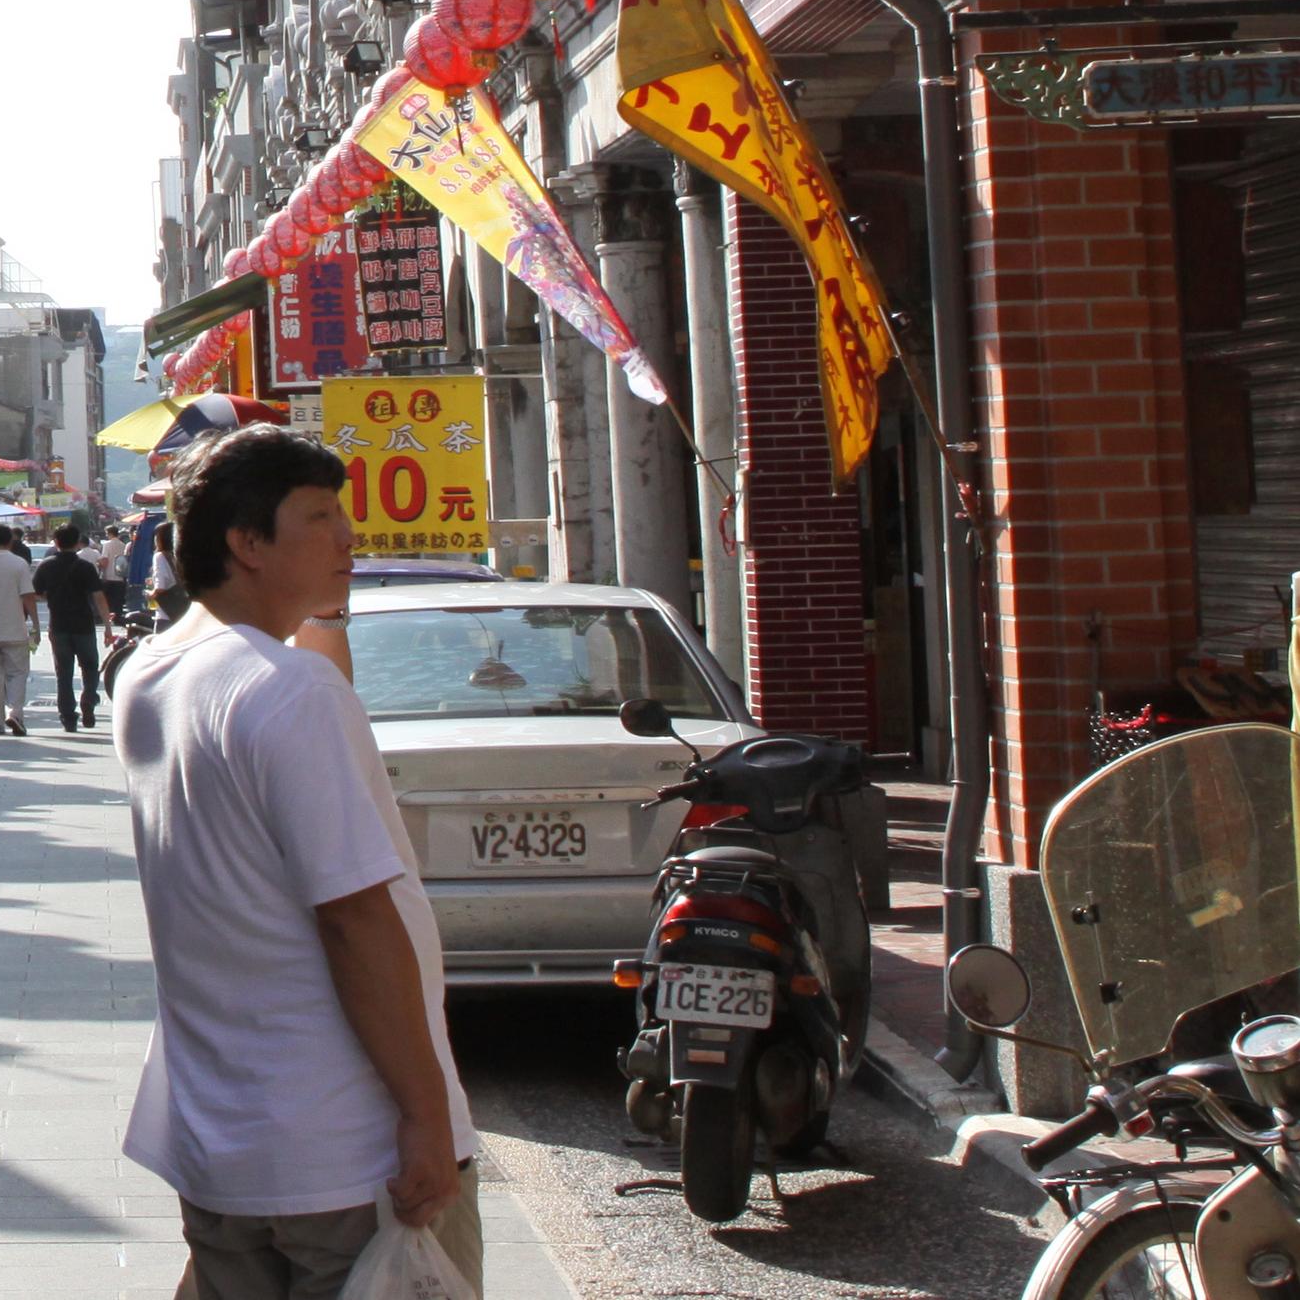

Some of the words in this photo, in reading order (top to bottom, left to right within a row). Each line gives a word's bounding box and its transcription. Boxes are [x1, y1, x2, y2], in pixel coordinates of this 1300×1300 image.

[396, 228, 423, 342] 研磨咖啡
[416, 225, 444, 342] 麻辣臭豆腐
[279, 271, 300, 340] 杏仁粉
[330, 420, 481, 454] 冬瓜茶
[438, 486, 476, 522] 元
[354, 531, 484, 550] 多明星採訪の店
[471, 821, 587, 860] V2-4329
[694, 926, 739, 939] KYMCO
[662, 981, 769, 1017] ICE-226
